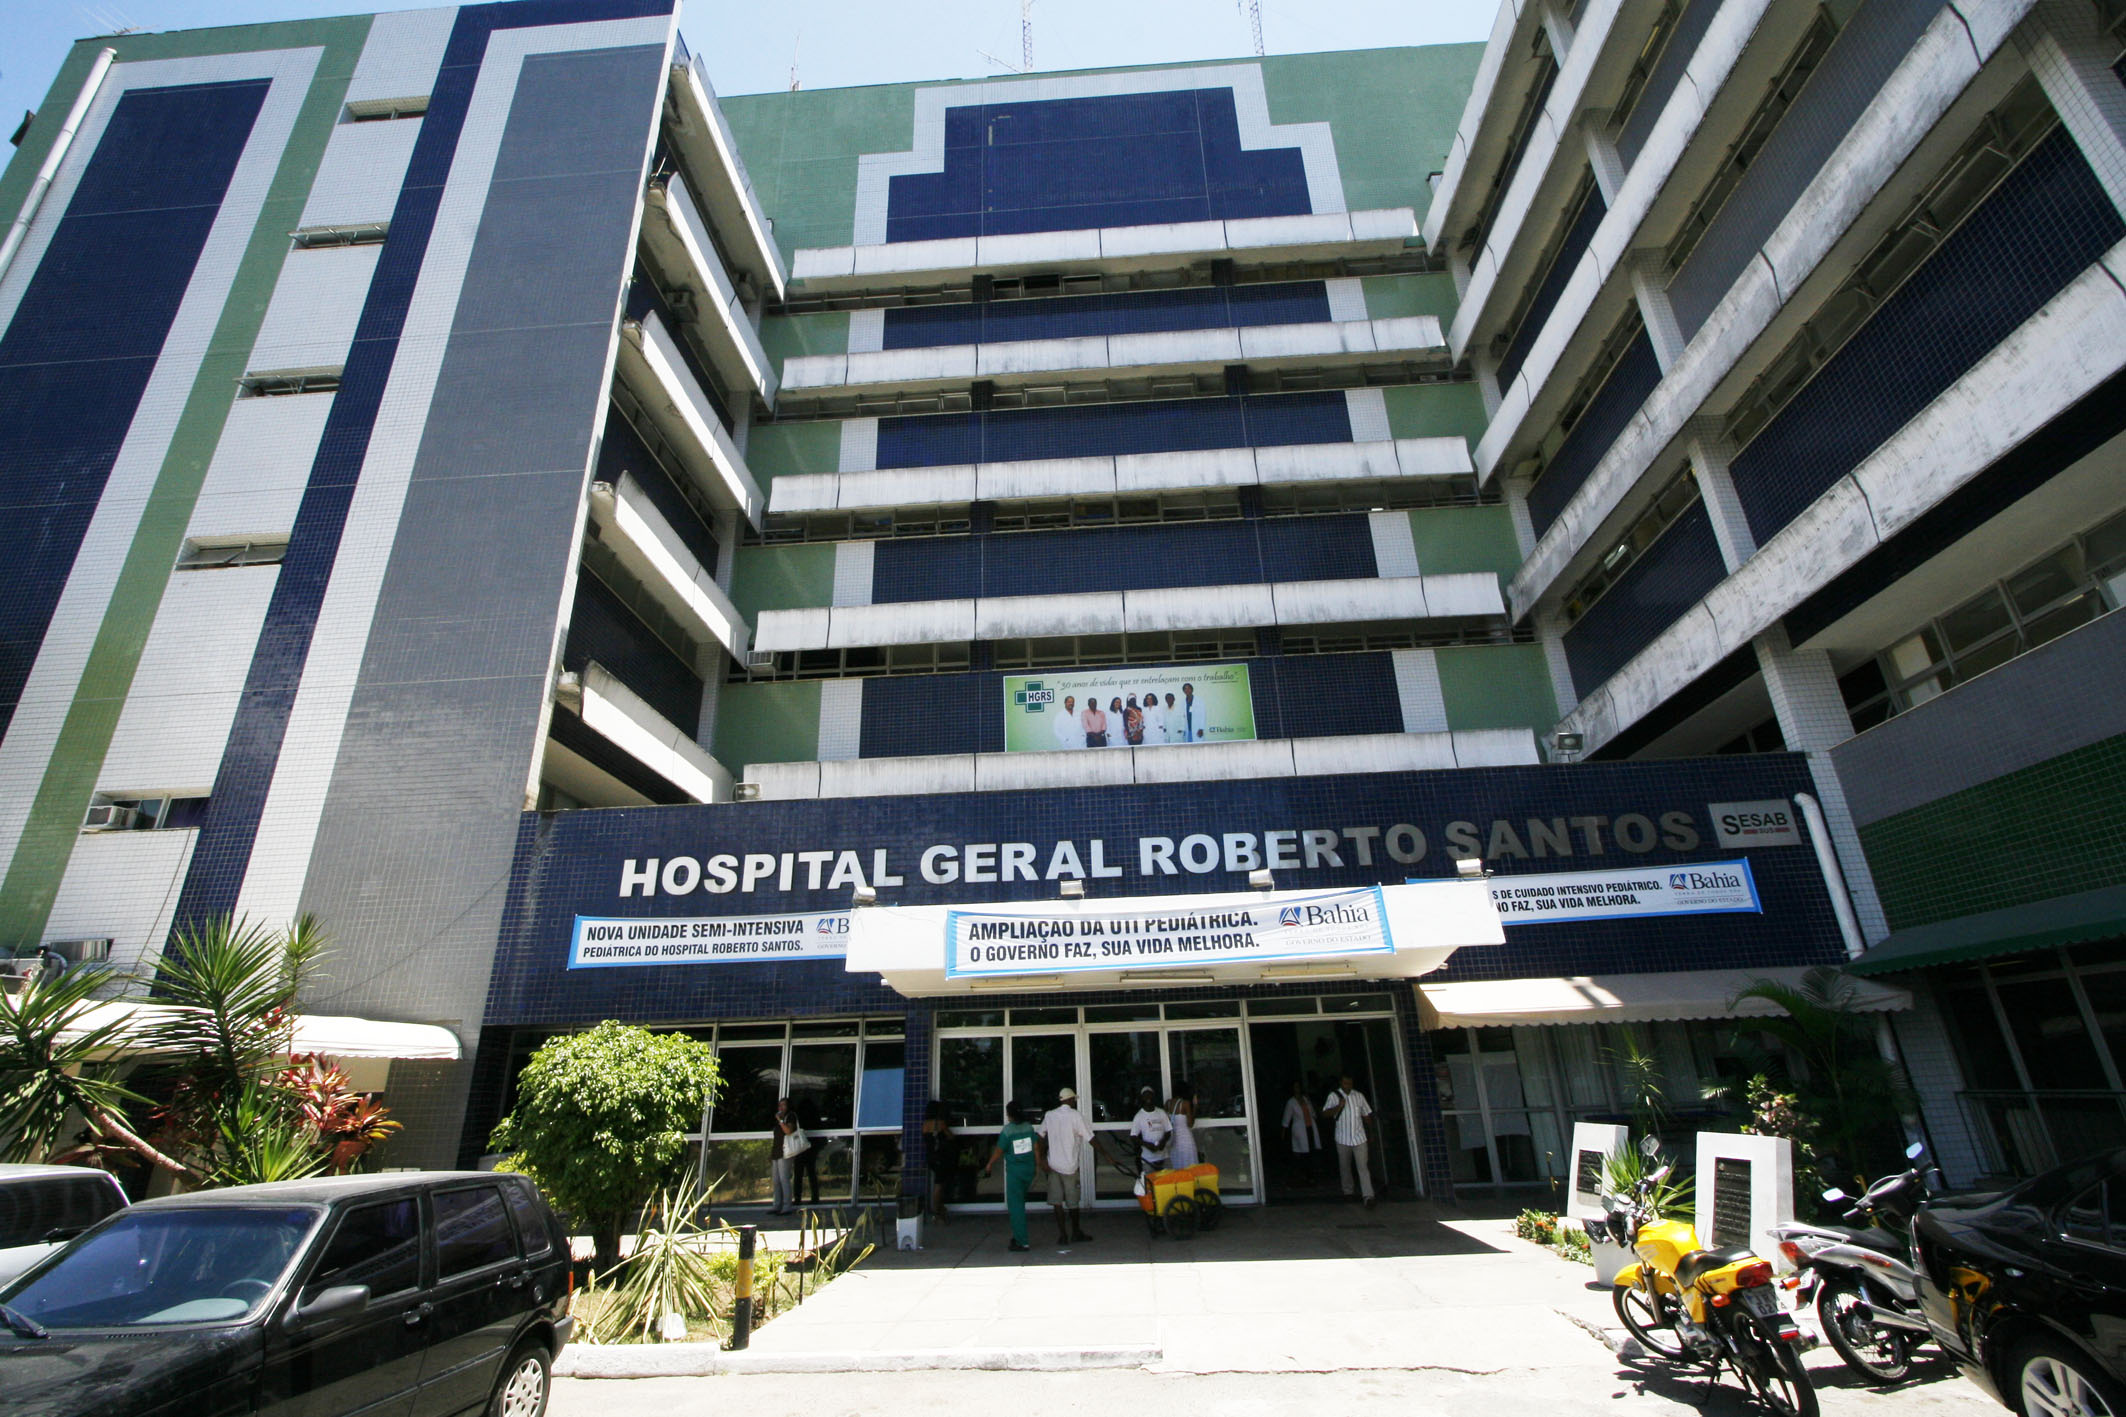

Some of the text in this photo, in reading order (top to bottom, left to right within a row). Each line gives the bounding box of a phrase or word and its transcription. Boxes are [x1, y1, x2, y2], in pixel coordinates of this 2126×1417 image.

[1028, 691, 1052, 702] HGRS
[1722, 812, 1788, 835] SESAB
[619, 811, 1699, 897] HOSPITAL GERAL ROBERTO SANTOS
[1501, 889, 1512, 899] DE
[1515, 887, 1555, 899] CUIDADO
[1557, 883, 1604, 896] INTENSIVO
[1607, 879, 1662, 893] PEDIÁTRICO.
[1689, 872, 1741, 889] Bahia
[1512, 900, 1534, 912] FAZ,
[1537, 898, 1557, 910] SUA
[1559, 896, 1585, 909] VIDA
[1587, 893, 1641, 908] MELHORA.
[1080, 920, 1104, 936] DA
[1110, 919, 1138, 935] UTI
[1145, 912, 1258, 933] PEDIÁTRICA.
[1305, 904, 1370, 926] Bahia
[587, 919, 804, 941] NOVA UNIDADE SEMI-INTENSIVA
[583, 944, 641, 958] PEDIÁTRICA
[645, 945, 659, 956] DO
[662, 944, 708, 955] HOSPITAL
[712, 941, 759, 954] ROBERTO
[762, 940, 803, 952] SANTOS.
[970, 932, 1260, 962] O GOVERNO FAZ, SUA VIDA MELHORA.
